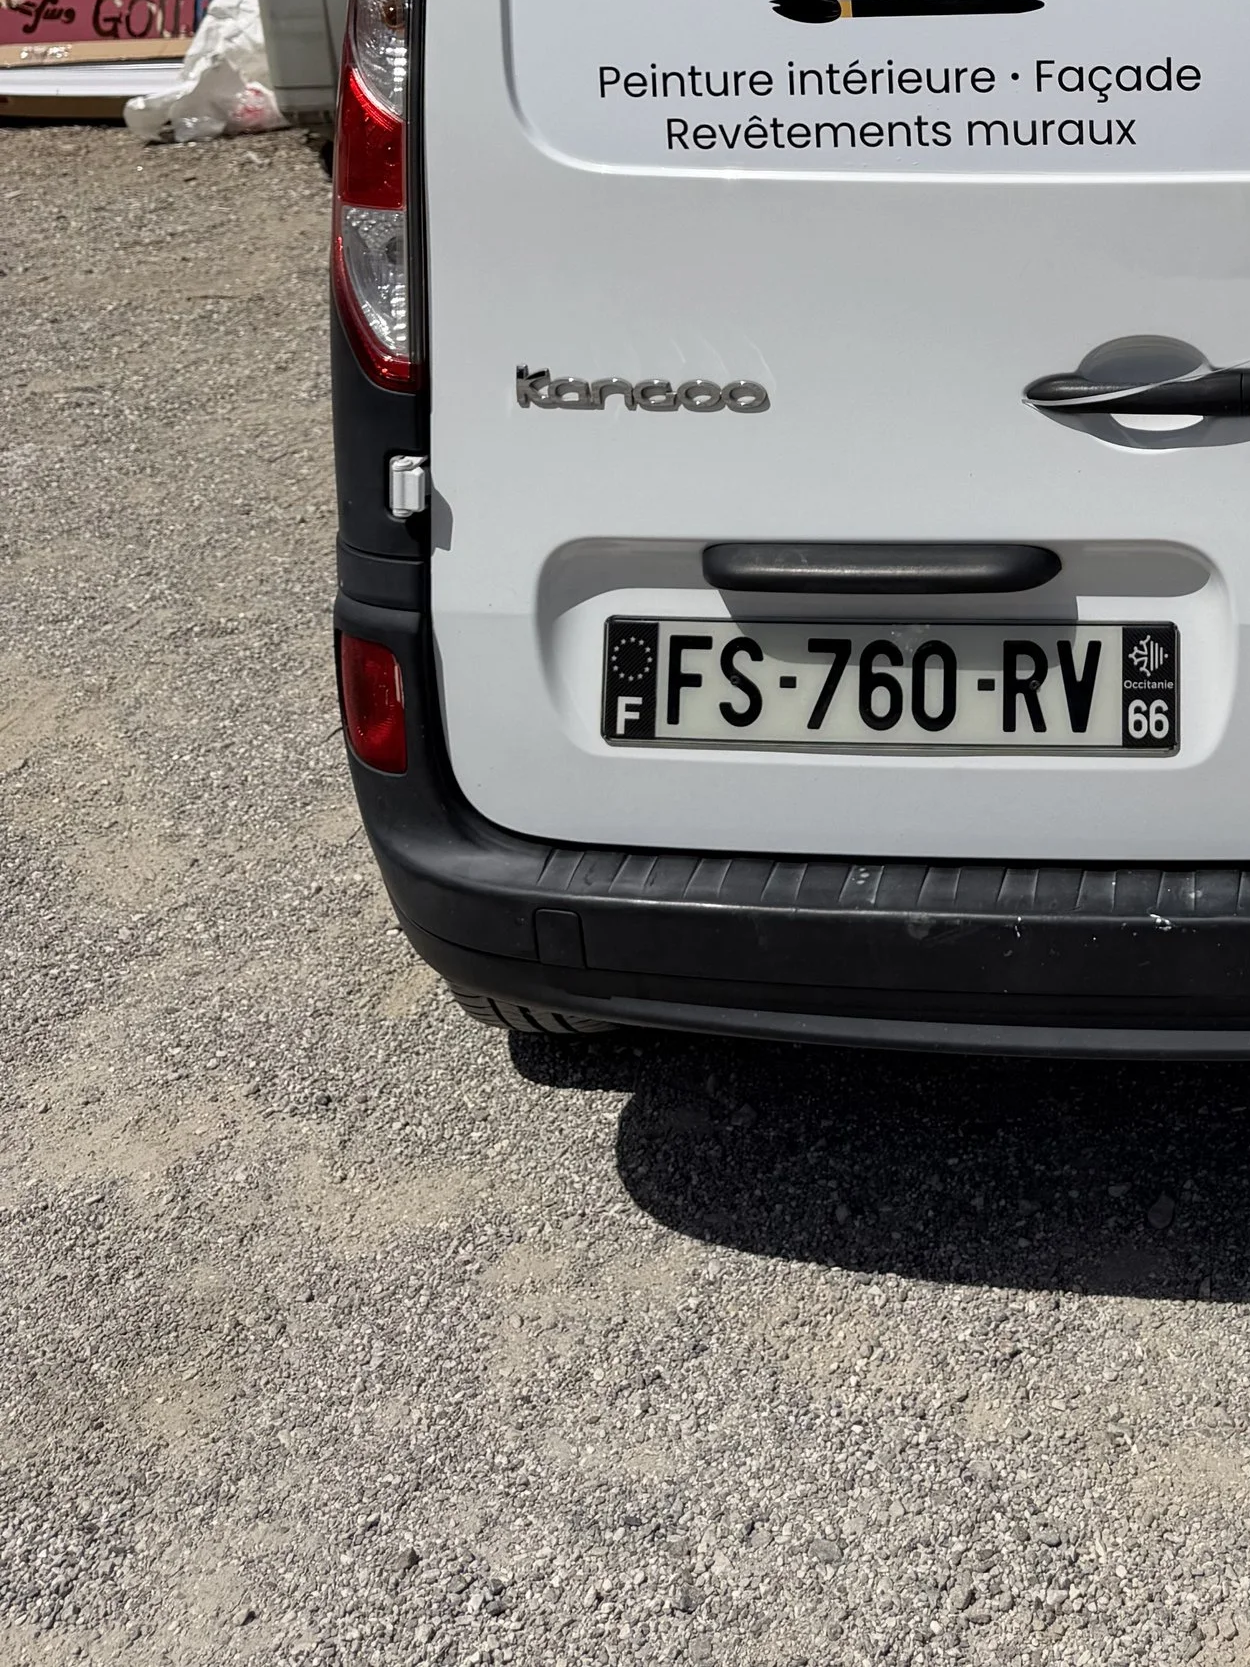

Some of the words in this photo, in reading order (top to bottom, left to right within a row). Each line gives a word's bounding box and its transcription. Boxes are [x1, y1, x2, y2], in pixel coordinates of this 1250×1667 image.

[598, 63, 774, 98] Peinture
[787, 59, 996, 96] intérieure
[1035, 56, 1202, 104] Façade
[666, 115, 952, 150] Revêtements
[967, 117, 1138, 147] muraux
[666, 634, 1102, 733] FS-760-RV
[1123, 679, 1174, 690] Occitanie
[616, 696, 643, 735] F
[1128, 699, 1170, 739] 66
